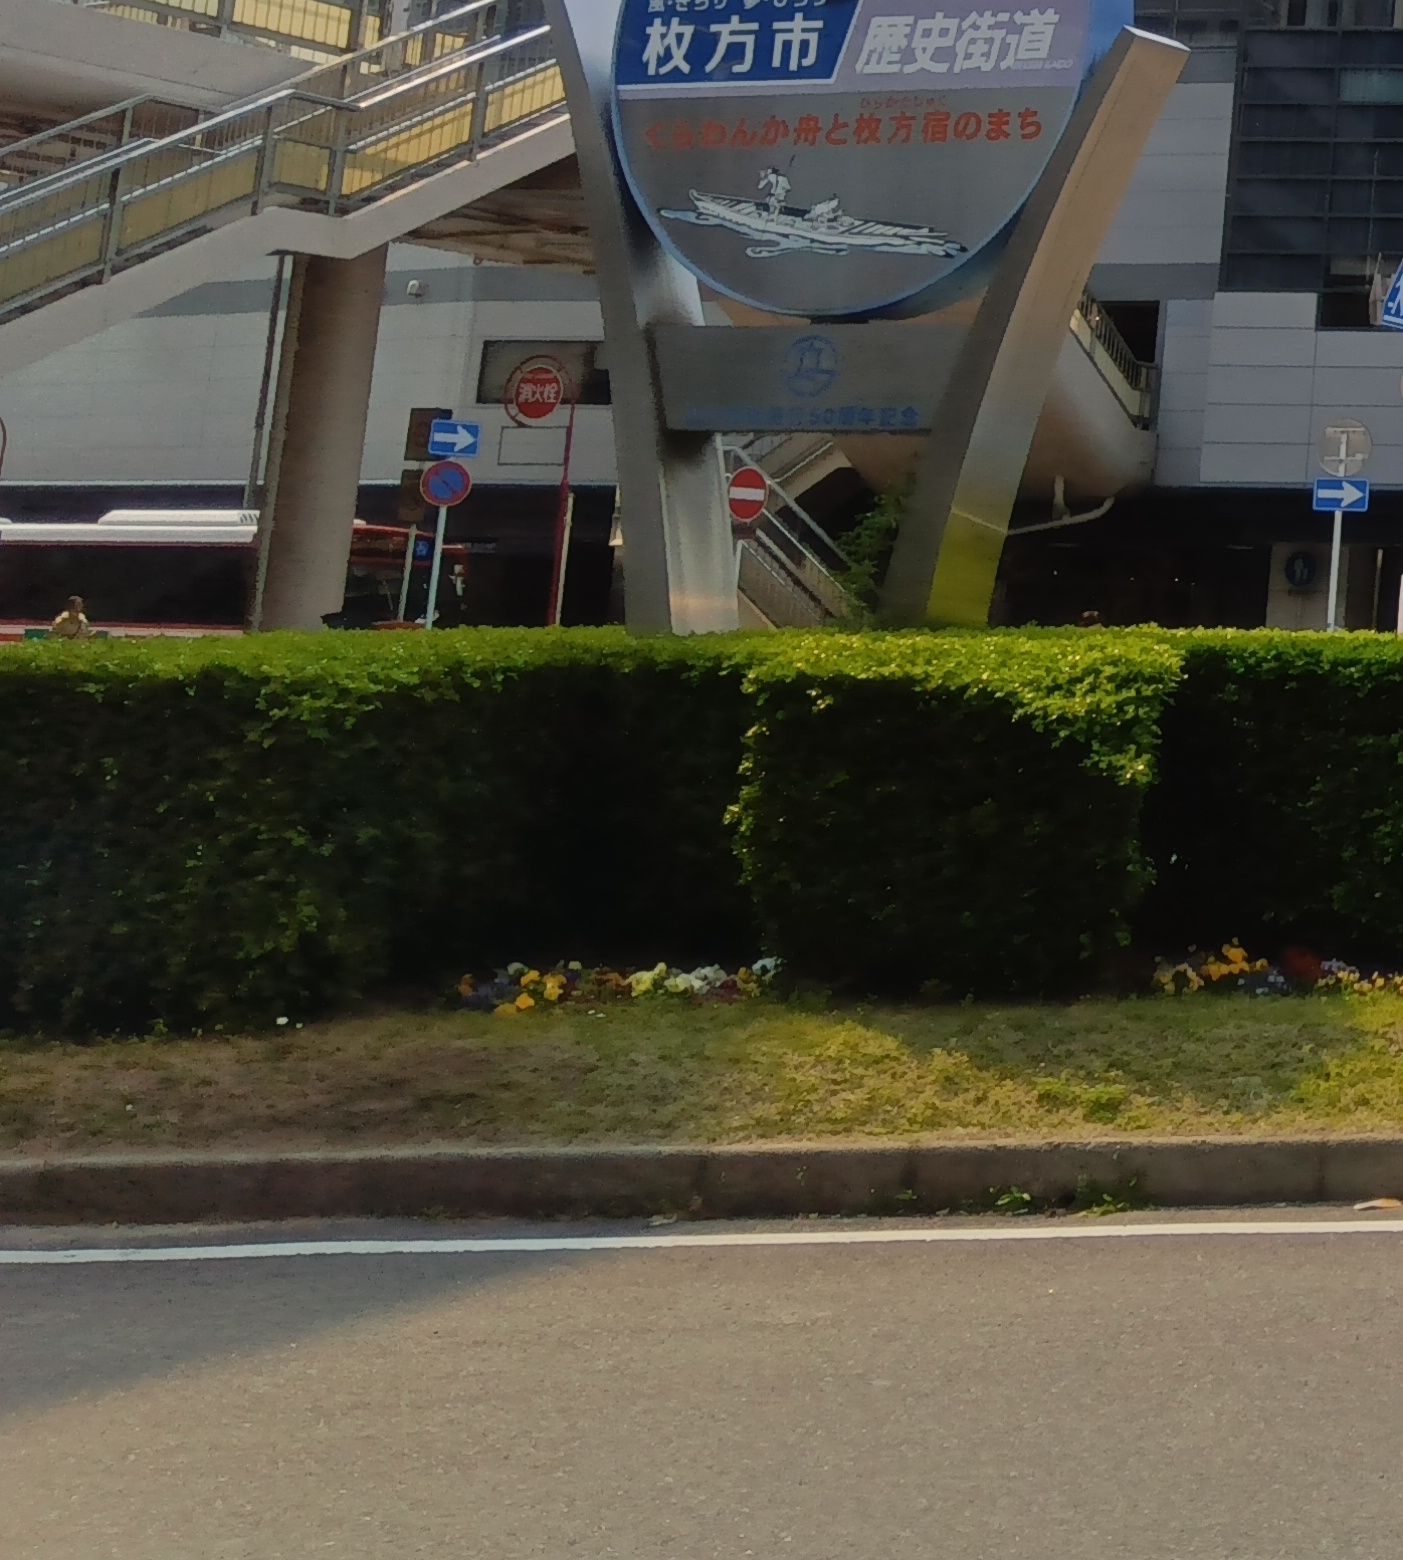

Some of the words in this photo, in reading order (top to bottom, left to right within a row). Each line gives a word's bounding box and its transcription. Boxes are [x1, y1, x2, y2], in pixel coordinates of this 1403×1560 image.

[642, 12, 824, 76] 枚方市
[855, 8, 1061, 74] 歴史街道
[519, 383, 558, 403] 消火栓
